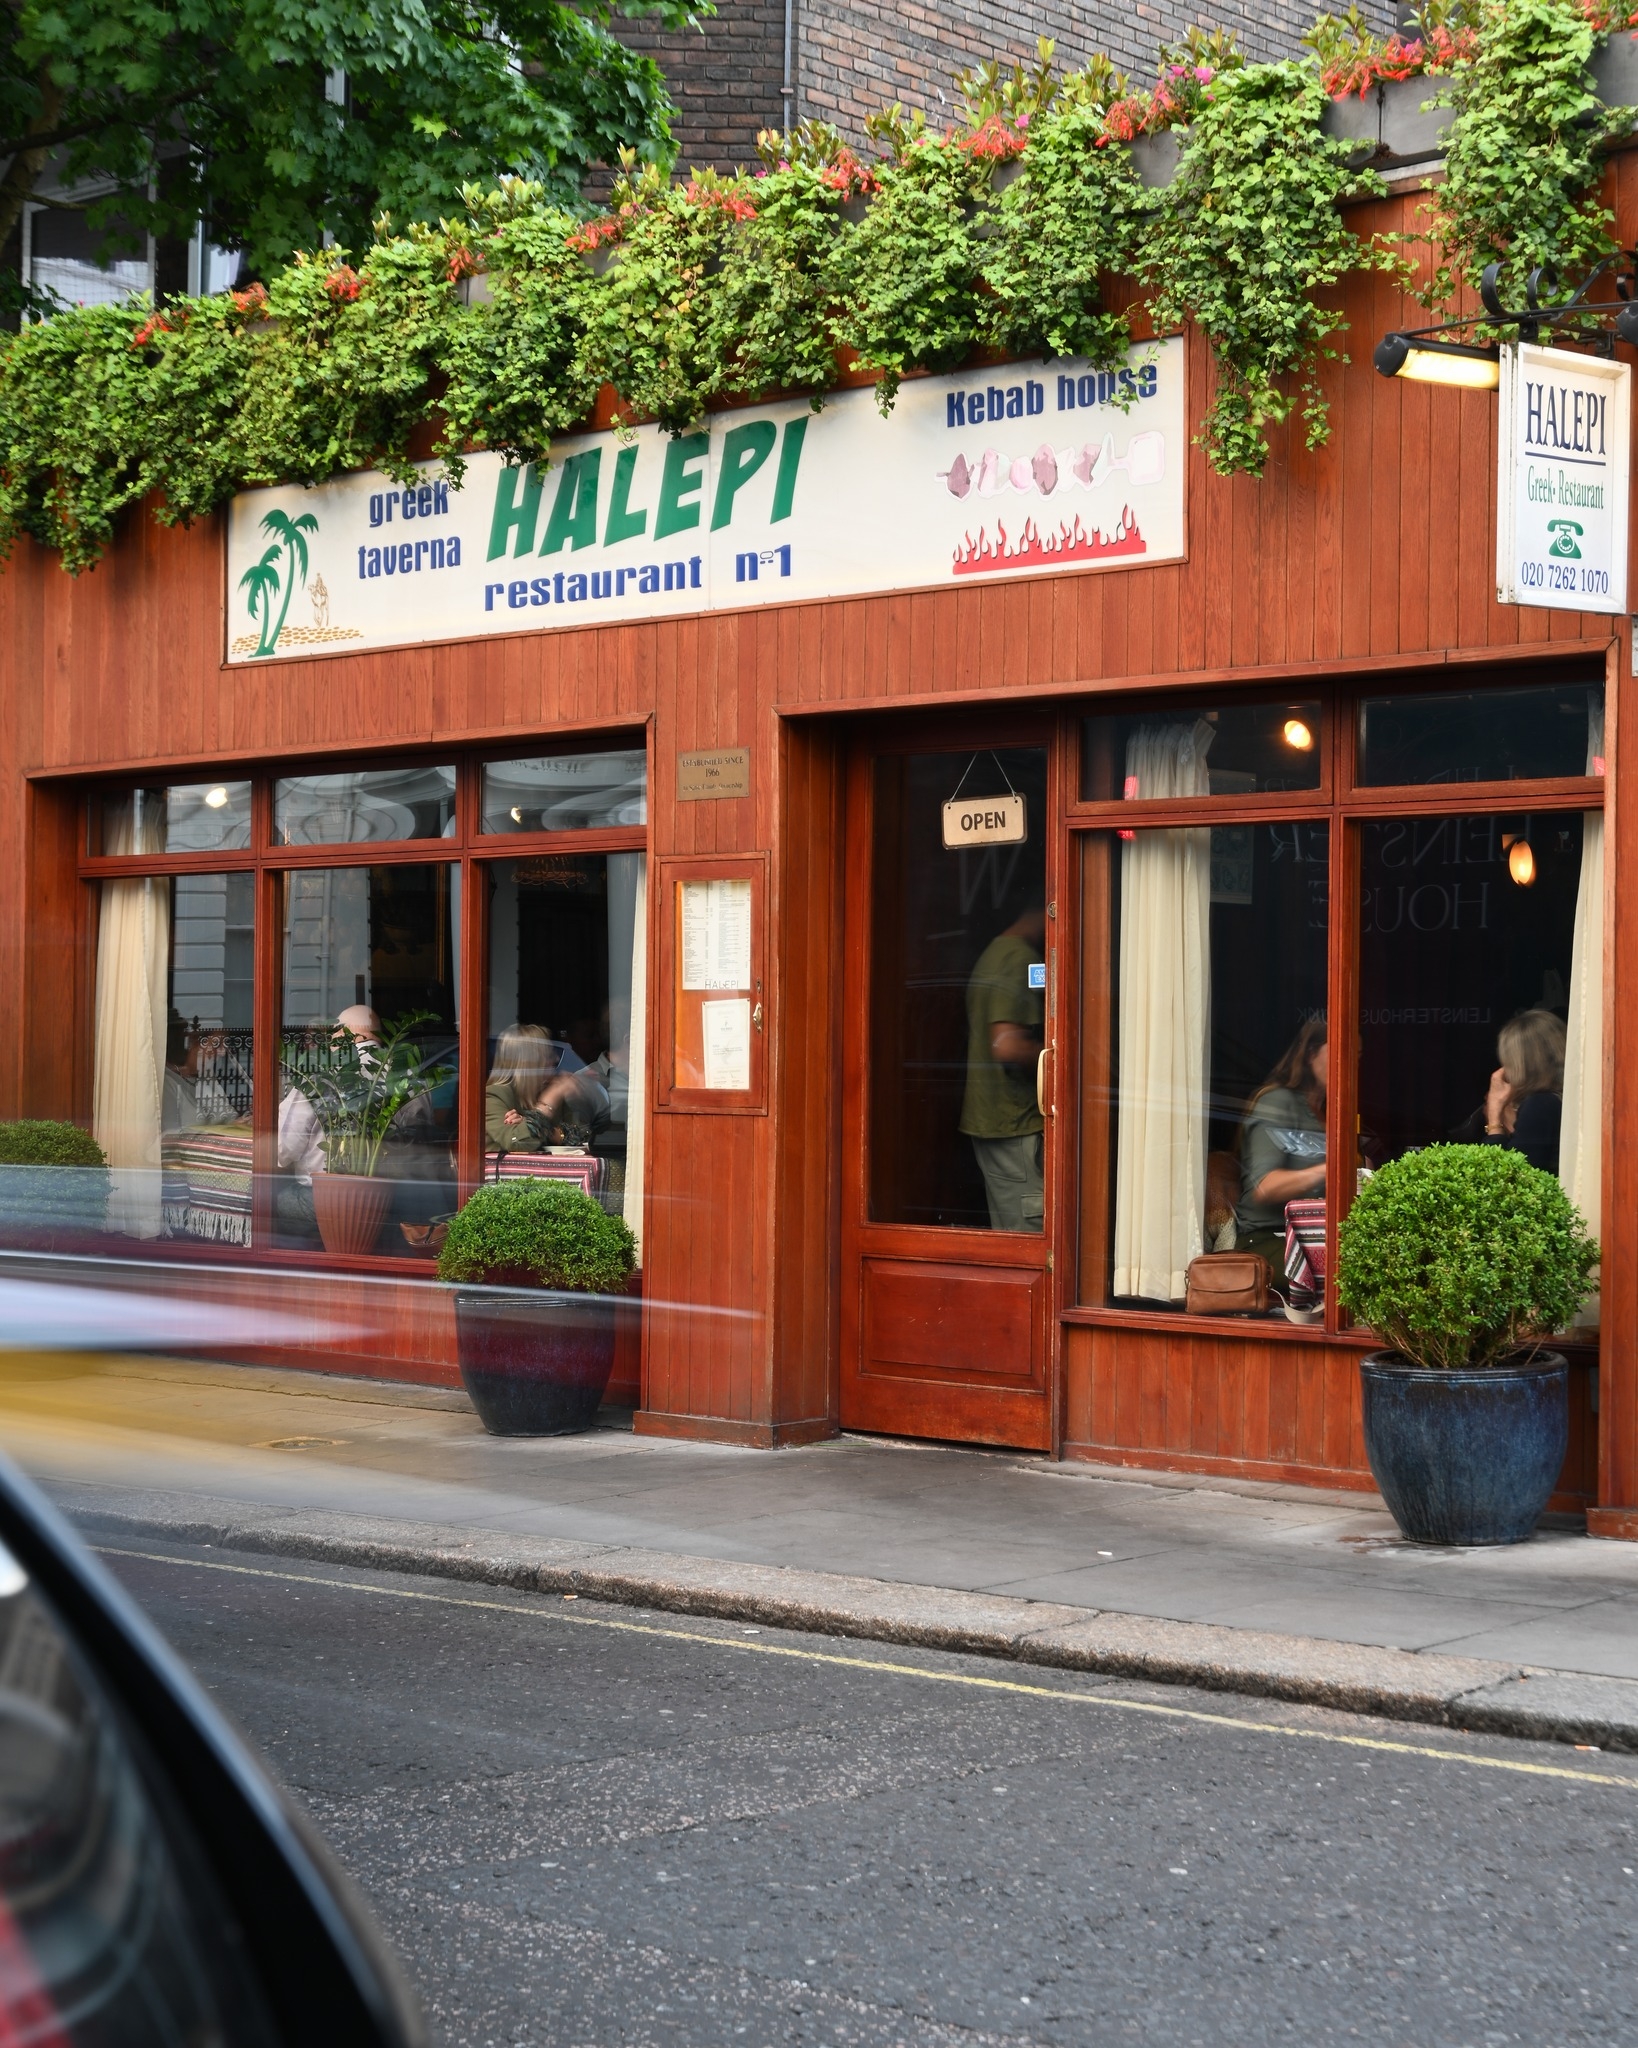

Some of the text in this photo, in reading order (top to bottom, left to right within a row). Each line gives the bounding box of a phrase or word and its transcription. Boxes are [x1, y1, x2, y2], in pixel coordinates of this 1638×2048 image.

[947, 364, 1157, 428] Kebab house
[1525, 382, 1607, 455] HALEPI
[369, 480, 448, 528] greek
[486, 416, 809, 563] HALEPI
[1558, 469, 1604, 509] Restaurant
[358, 536, 461, 579] taverna
[1522, 561, 1609, 594] 020 7262 1070
[484, 555, 702, 611] restaurant
[705, 768, 720, 777] 1966
[725, 756, 744, 764] SINCE
[960, 811, 1006, 831] OPEN
[704, 980, 739, 989] HALEPI
